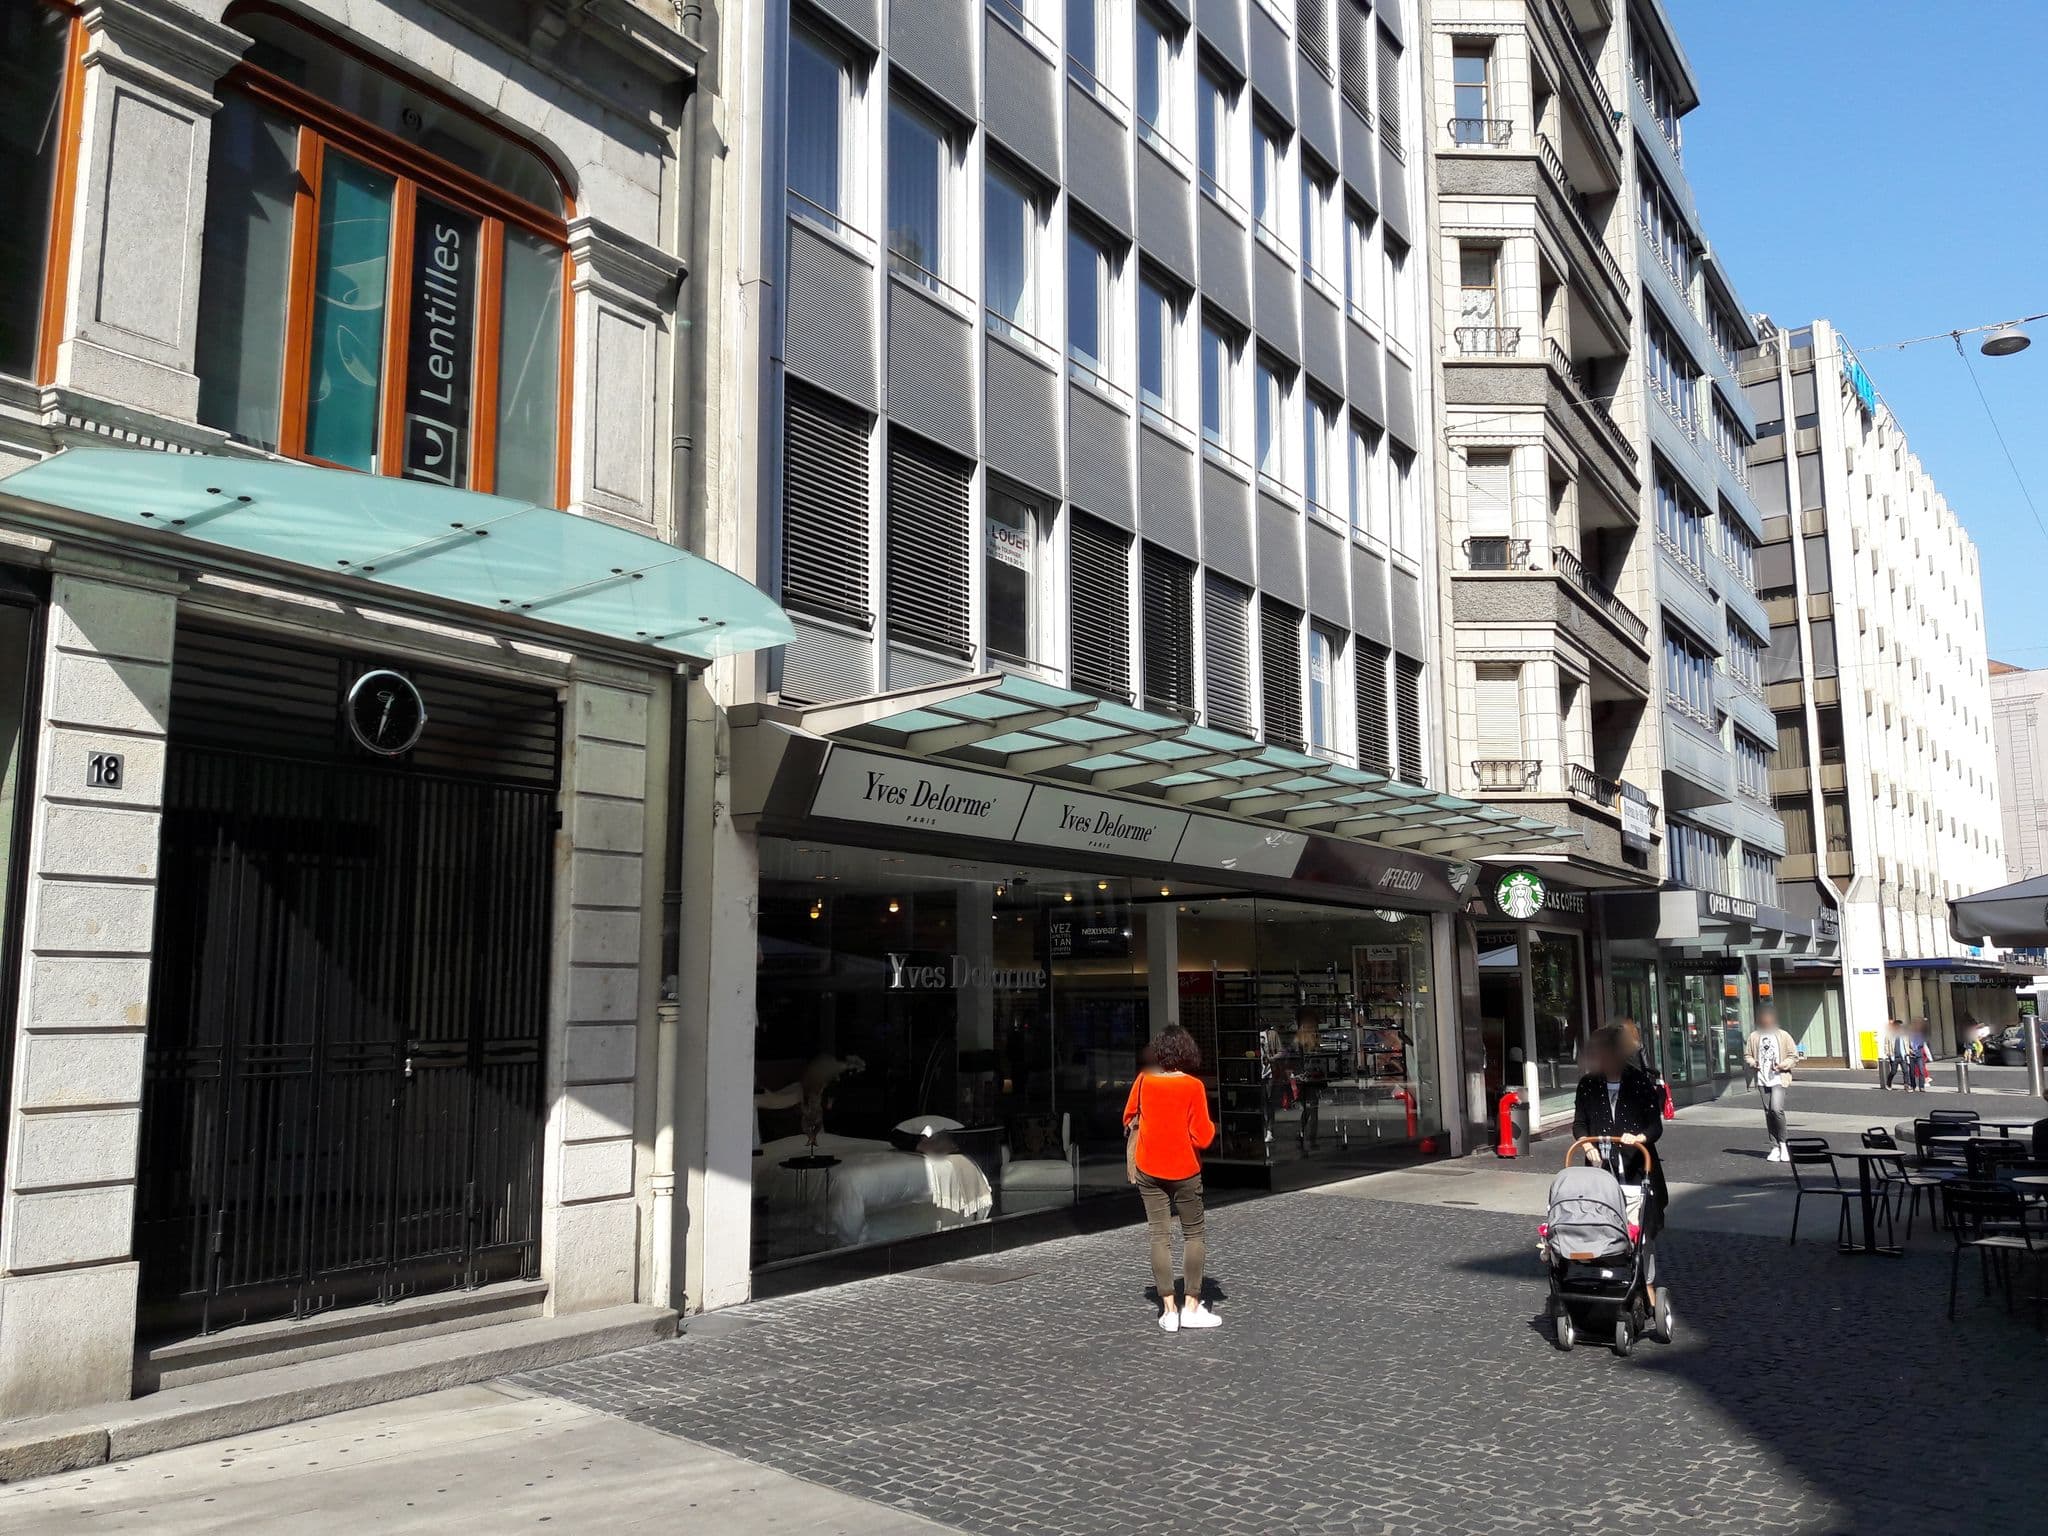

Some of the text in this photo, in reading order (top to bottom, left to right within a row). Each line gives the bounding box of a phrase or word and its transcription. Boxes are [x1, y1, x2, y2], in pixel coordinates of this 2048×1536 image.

[420, 223, 461, 405] Lentilles
[992, 525, 1030, 552] LOUER
[90, 755, 120, 785] 18
[863, 771, 908, 805] Yves
[906, 815, 936, 825] PARIS
[1059, 804, 1091, 833] Yves
[1088, 841, 1111, 849] PARIS
[1378, 867, 1424, 890] AFFLELOU
[1561, 892, 1585, 913] COFFEE
[1709, 893, 1757, 919] OPERA GALLERY
[886, 951, 1047, 990] Yves Delorme
[1953, 974, 1976, 982] CLER
